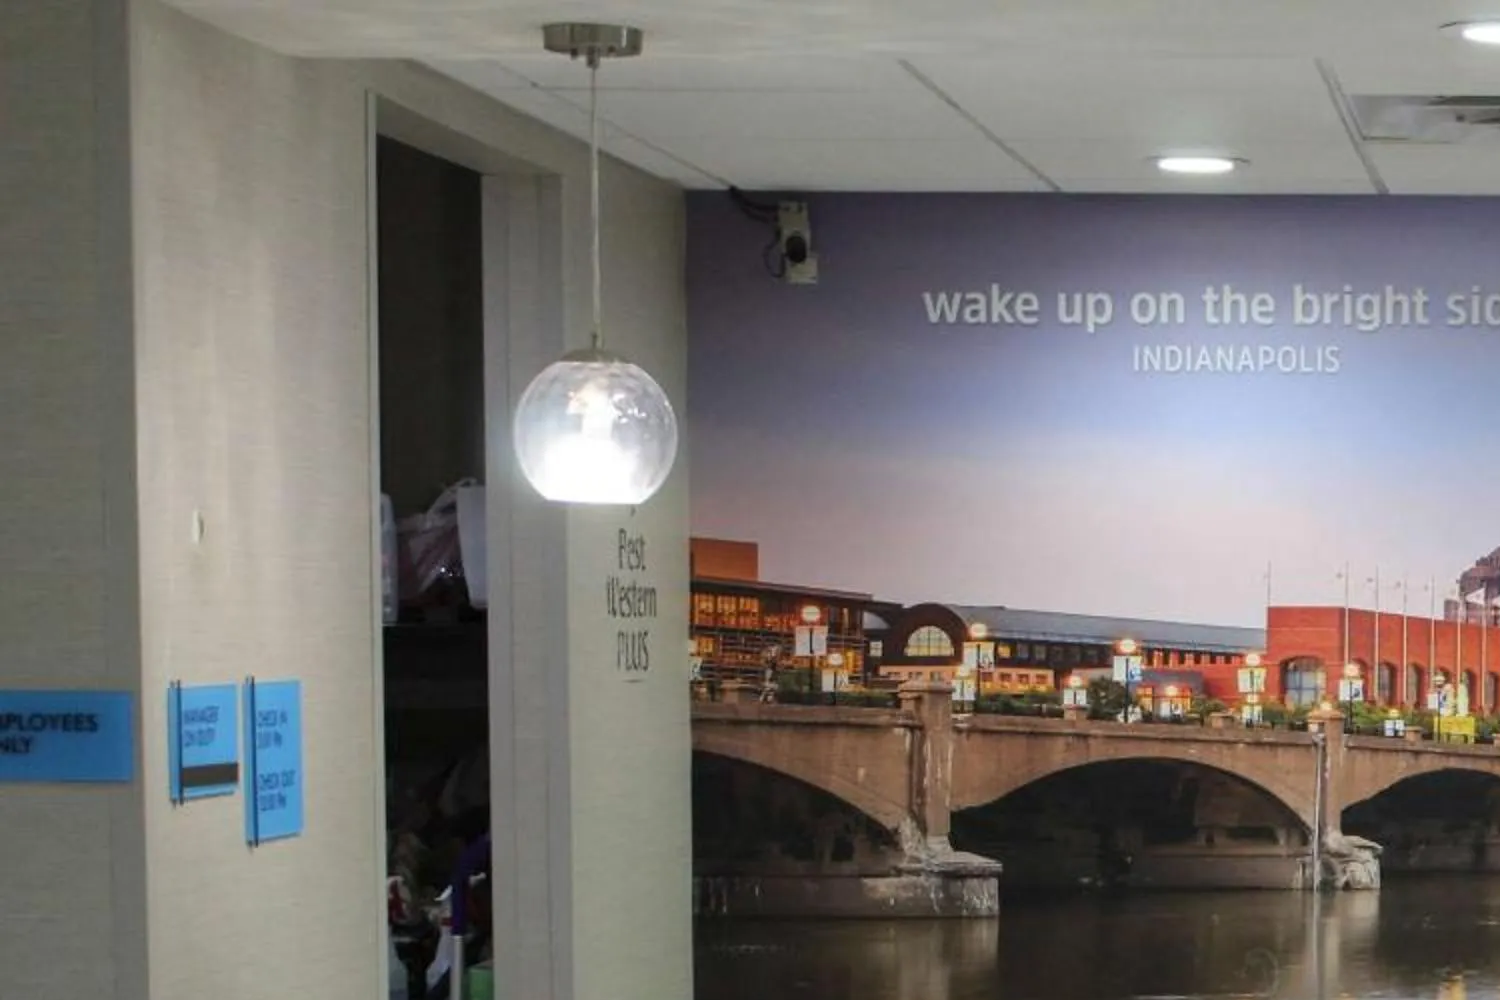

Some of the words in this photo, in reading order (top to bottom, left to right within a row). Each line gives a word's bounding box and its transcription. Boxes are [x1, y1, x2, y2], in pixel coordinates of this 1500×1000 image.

[922, 283, 1041, 325] wake
[1057, 291, 1113, 334] up
[1130, 291, 1186, 325] on
[1202, 284, 1276, 326] the
[1293, 284, 1430, 332] bright
[1132, 344, 1341, 374] INDIANAPOLIS
[616, 630, 649, 672] PLUS
